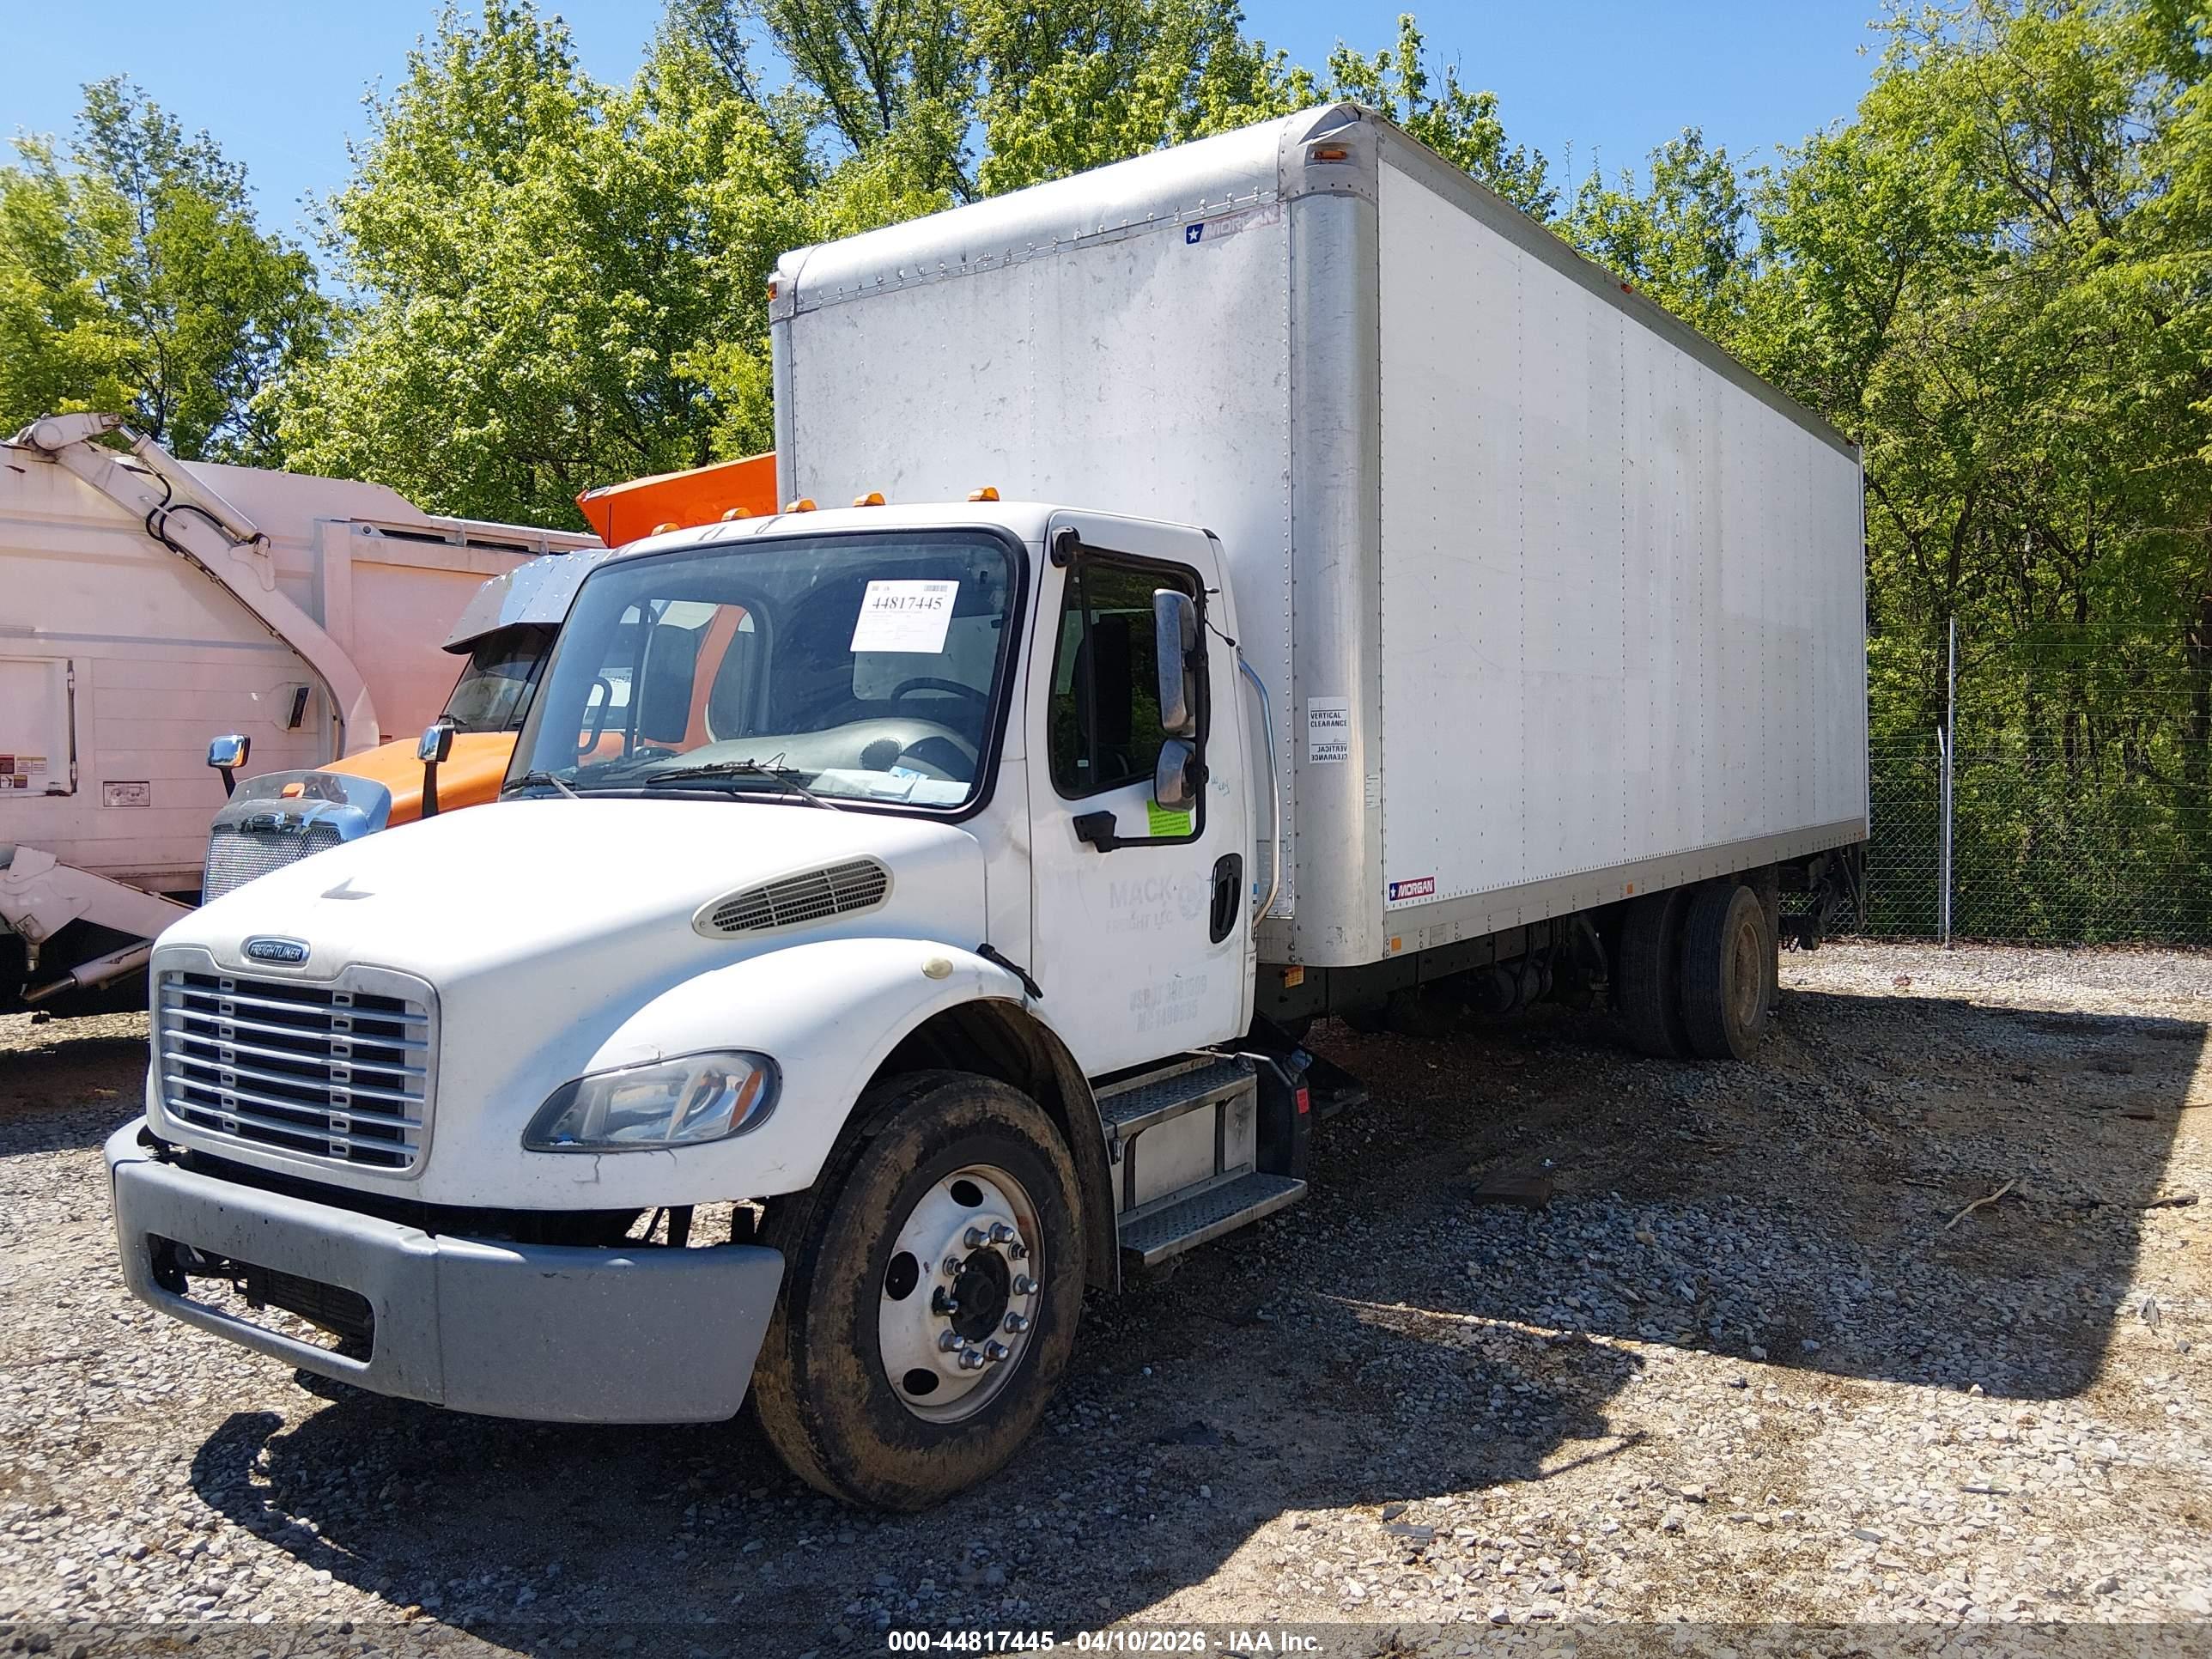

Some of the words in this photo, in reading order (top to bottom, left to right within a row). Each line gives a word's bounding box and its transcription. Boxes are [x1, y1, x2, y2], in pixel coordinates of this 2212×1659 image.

[872, 596, 944, 611] 44817445
[1310, 720, 1347, 728] CLEARANCE
[1109, 874, 1173, 908] MACK
[1397, 879, 1434, 897] MORGAN
[249, 944, 301, 959] FREIGHTLINER
